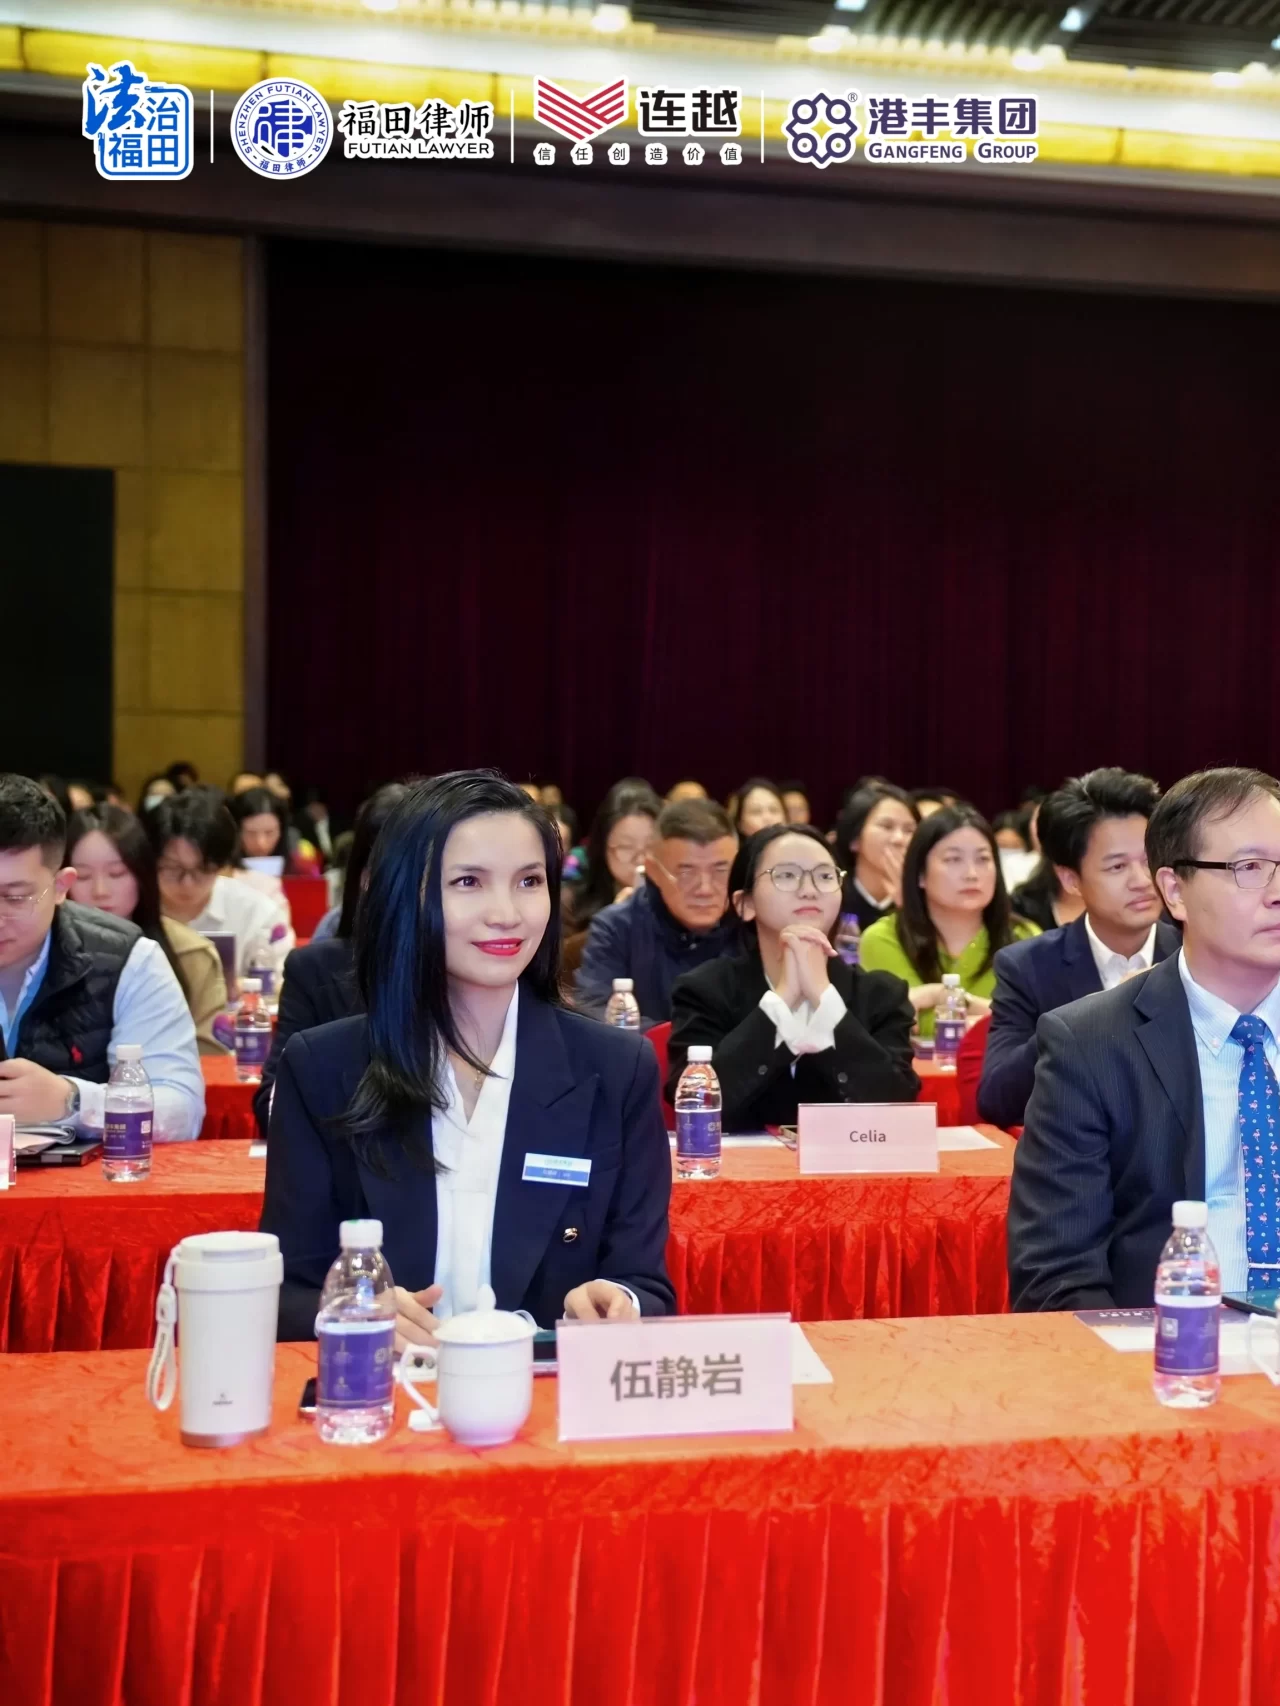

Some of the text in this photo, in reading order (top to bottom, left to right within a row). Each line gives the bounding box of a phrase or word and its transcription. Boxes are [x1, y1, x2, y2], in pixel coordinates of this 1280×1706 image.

[849, 1129, 887, 1143] Celia
[609, 1352, 744, 1402] 伍静岩
